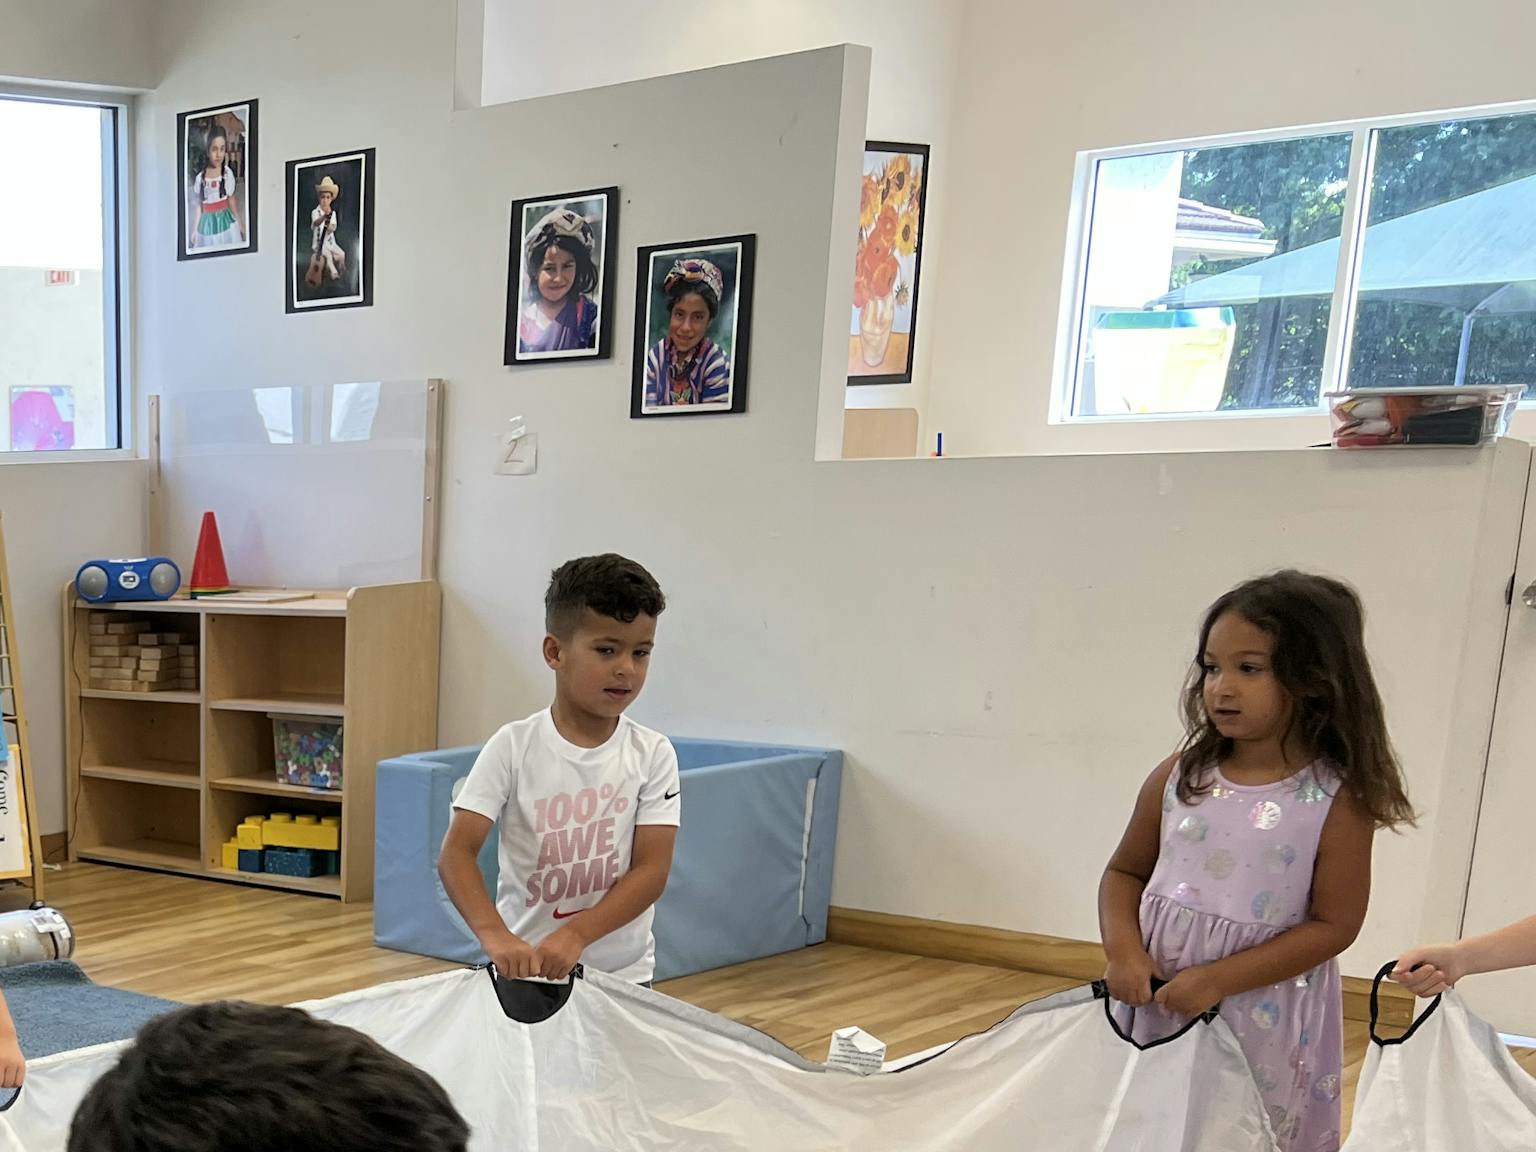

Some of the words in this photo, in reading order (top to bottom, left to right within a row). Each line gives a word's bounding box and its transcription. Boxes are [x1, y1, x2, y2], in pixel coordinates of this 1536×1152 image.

[533, 780, 629, 834] 100%
[536, 817, 615, 871] AWE
[525, 850, 619, 907] SOME
